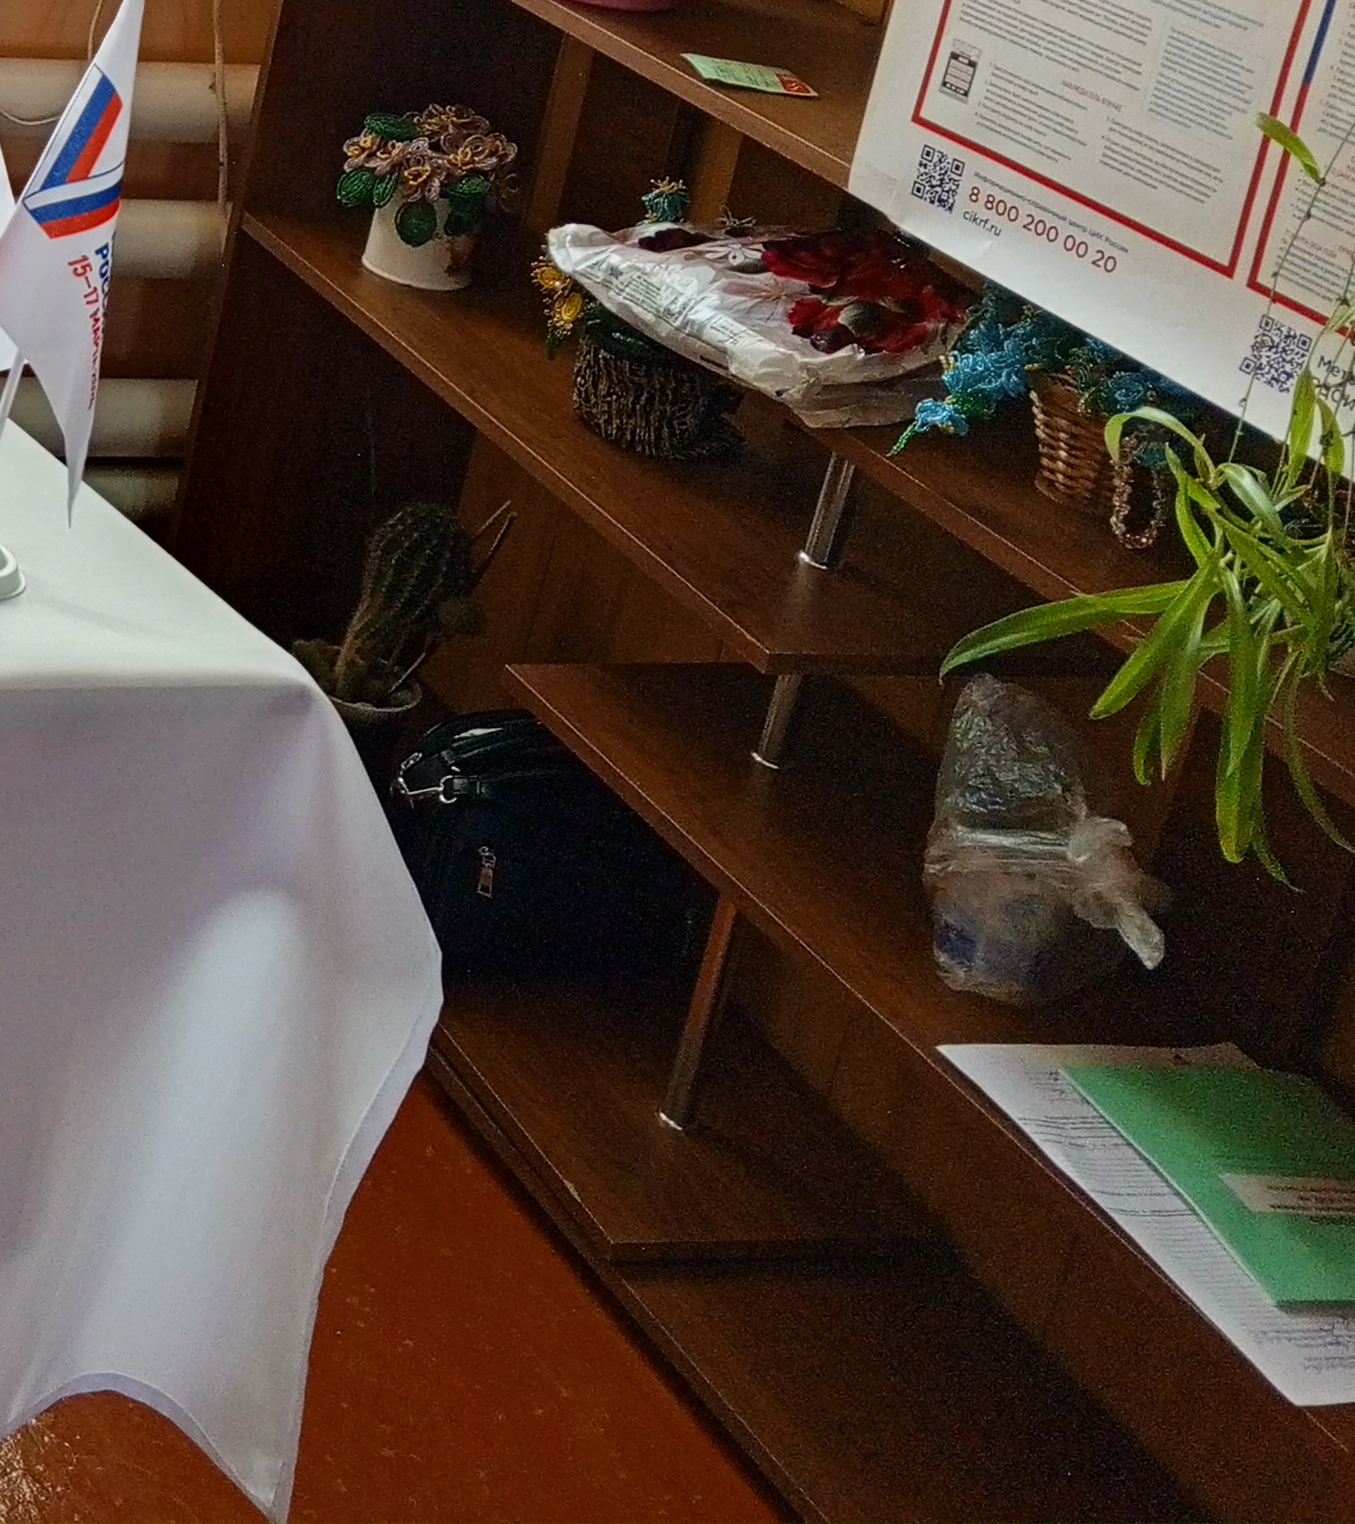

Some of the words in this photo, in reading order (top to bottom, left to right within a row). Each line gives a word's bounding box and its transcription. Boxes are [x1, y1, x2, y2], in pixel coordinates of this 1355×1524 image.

[962, 209, 1002, 237] cikrf.ru
[968, 186, 981, 204] 8
[984, 194, 1020, 223] 800
[1022, 213, 1059, 243] 200
[1063, 234, 1089, 258] 00
[1090, 249, 1117, 273] 20
[1087, 228, 1104, 241] ЦИК
